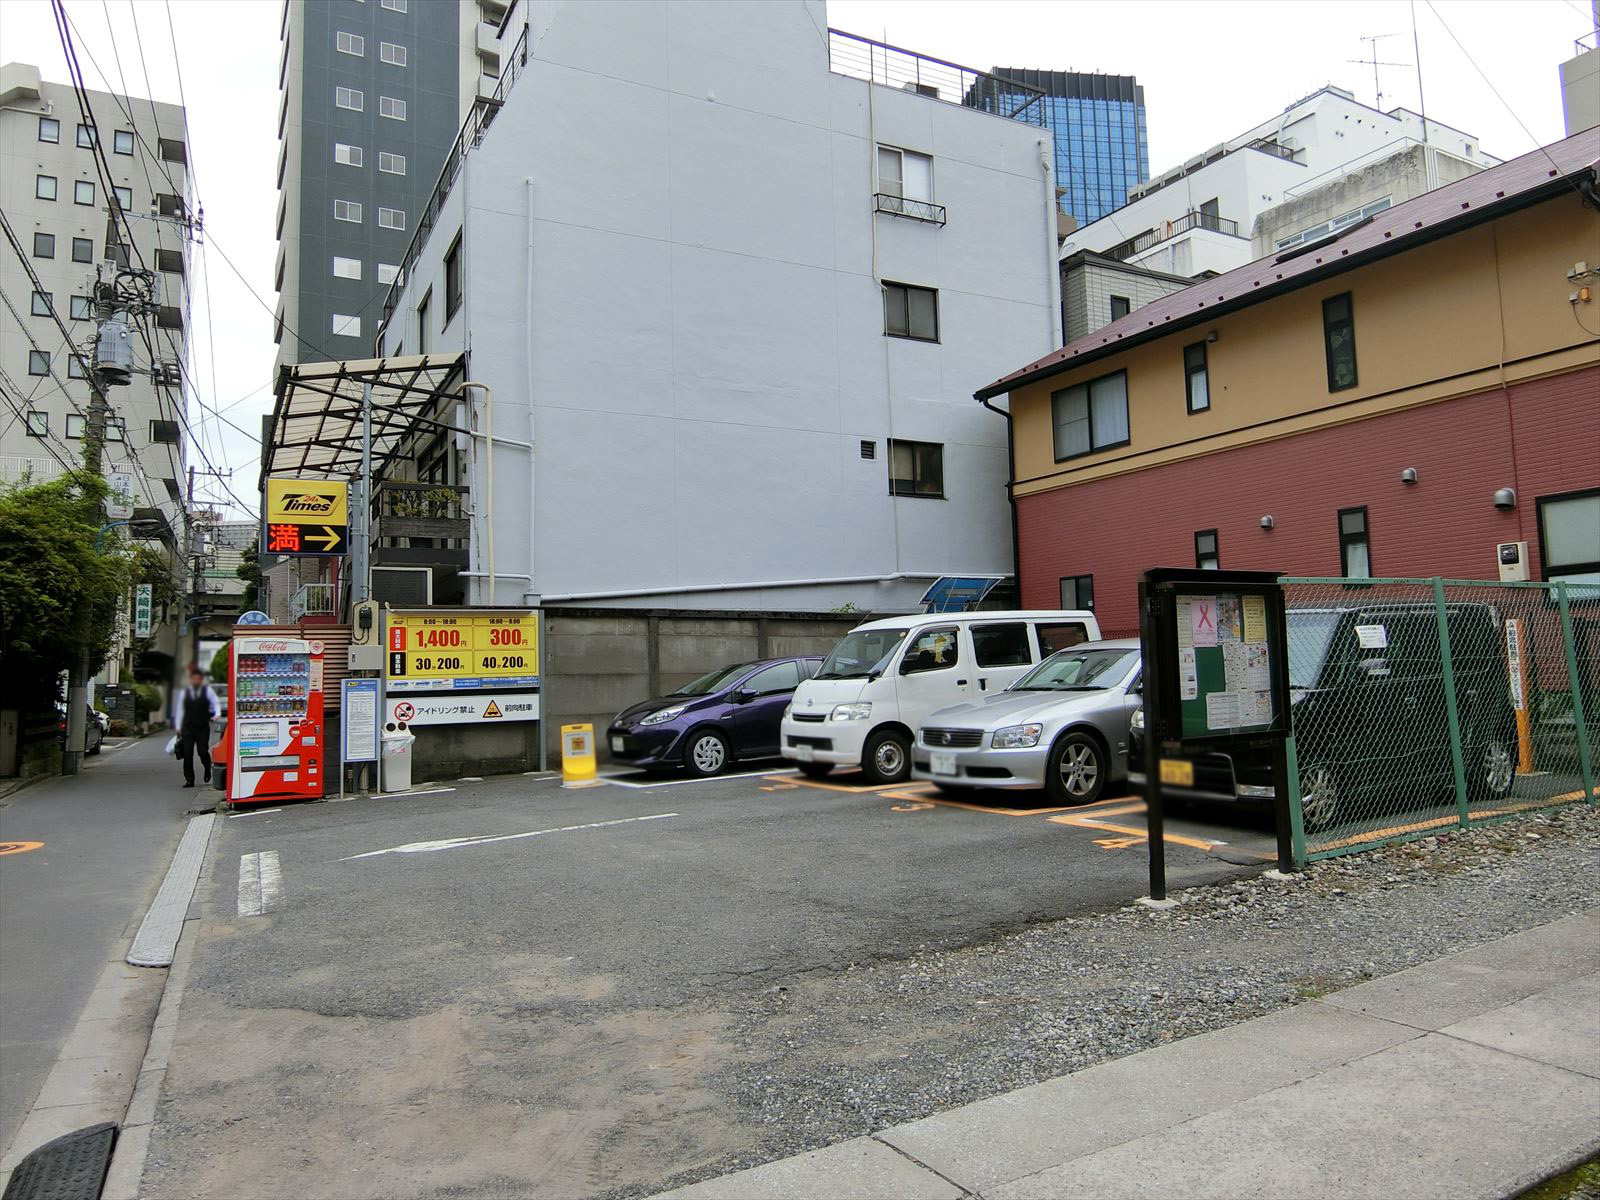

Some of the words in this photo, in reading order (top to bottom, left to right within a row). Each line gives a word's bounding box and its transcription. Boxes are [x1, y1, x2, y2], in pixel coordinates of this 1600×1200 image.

[282, 496, 332, 511] Times
[269, 525, 299, 551] 満
[416, 629, 467, 649] 1,400円
[490, 628, 528, 646] 300円
[417, 705, 476, 716] アイドリング禁止
[504, 703, 534, 713] 前向駐車
